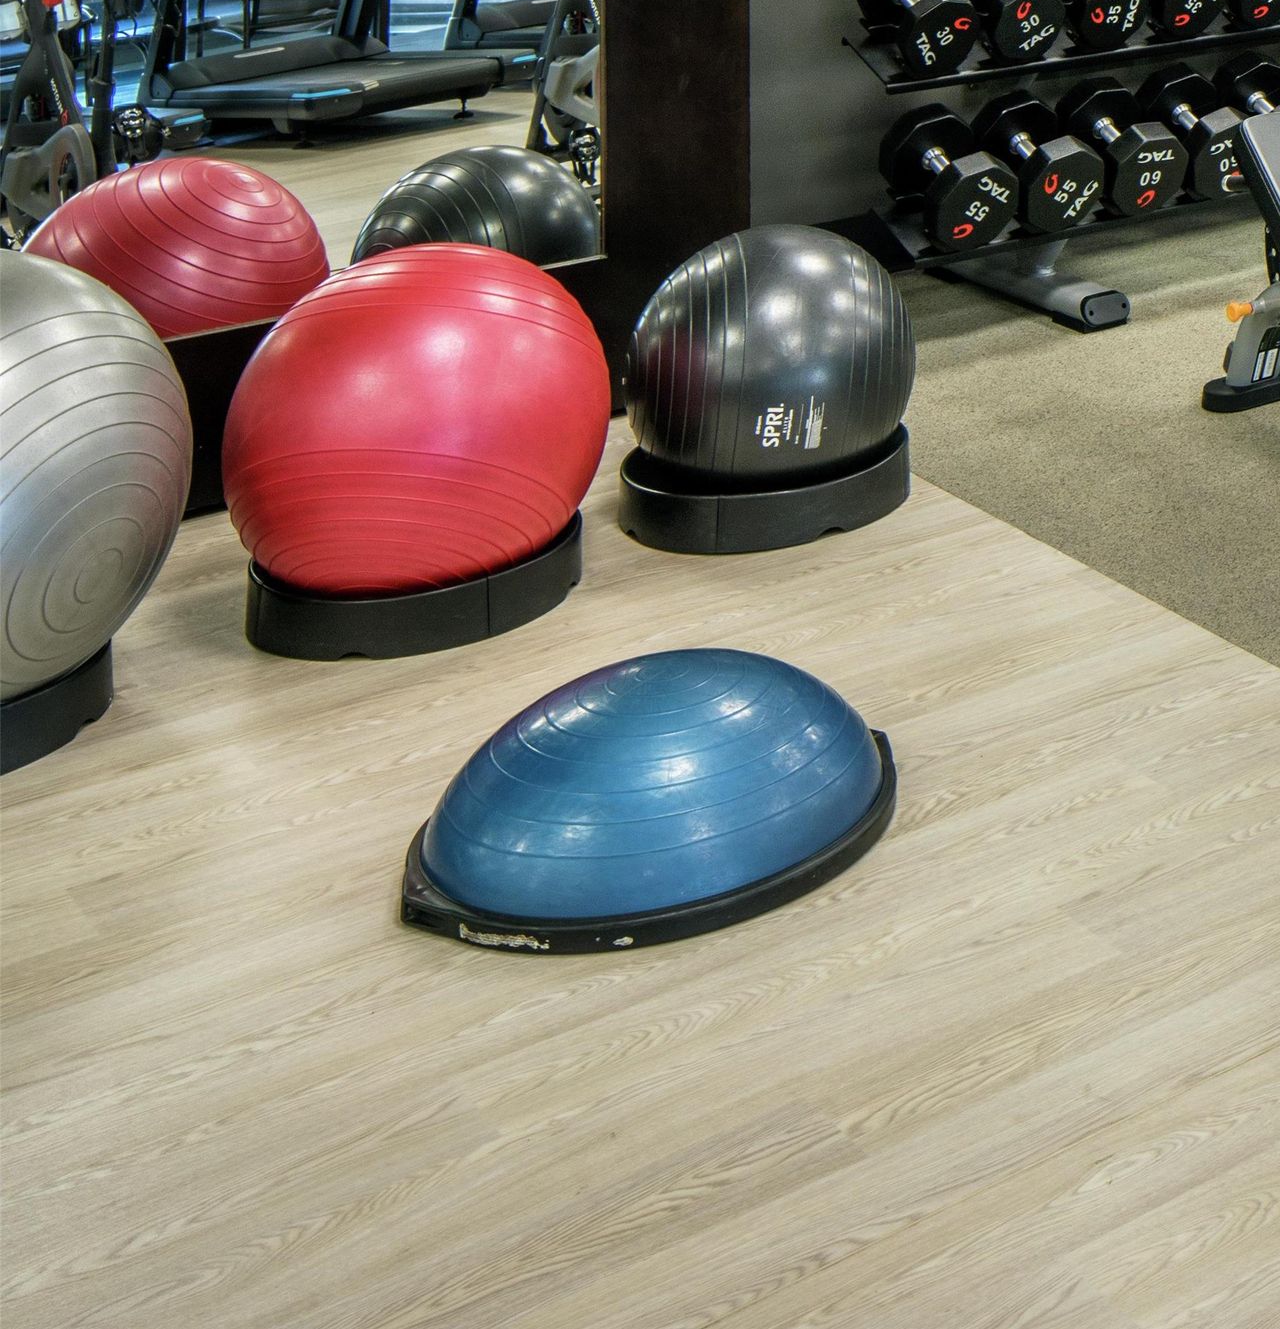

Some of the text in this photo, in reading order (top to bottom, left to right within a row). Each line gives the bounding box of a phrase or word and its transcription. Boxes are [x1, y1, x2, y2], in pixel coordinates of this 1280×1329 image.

[1020, 15, 1040, 33] 30
[1106, 5, 1122, 24] 35
[936, 27, 954, 46] 30
[1019, 24, 1055, 52] TAG
[916, 33, 936, 66] TAG
[1137, 149, 1175, 163] TAG
[977, 176, 1011, 203] TAG
[1140, 170, 1161, 186] 60
[1054, 179, 1077, 204] 55
[1063, 180, 1099, 219] TAG
[965, 200, 990, 222] 55
[762, 403, 784, 447] SPRI.
